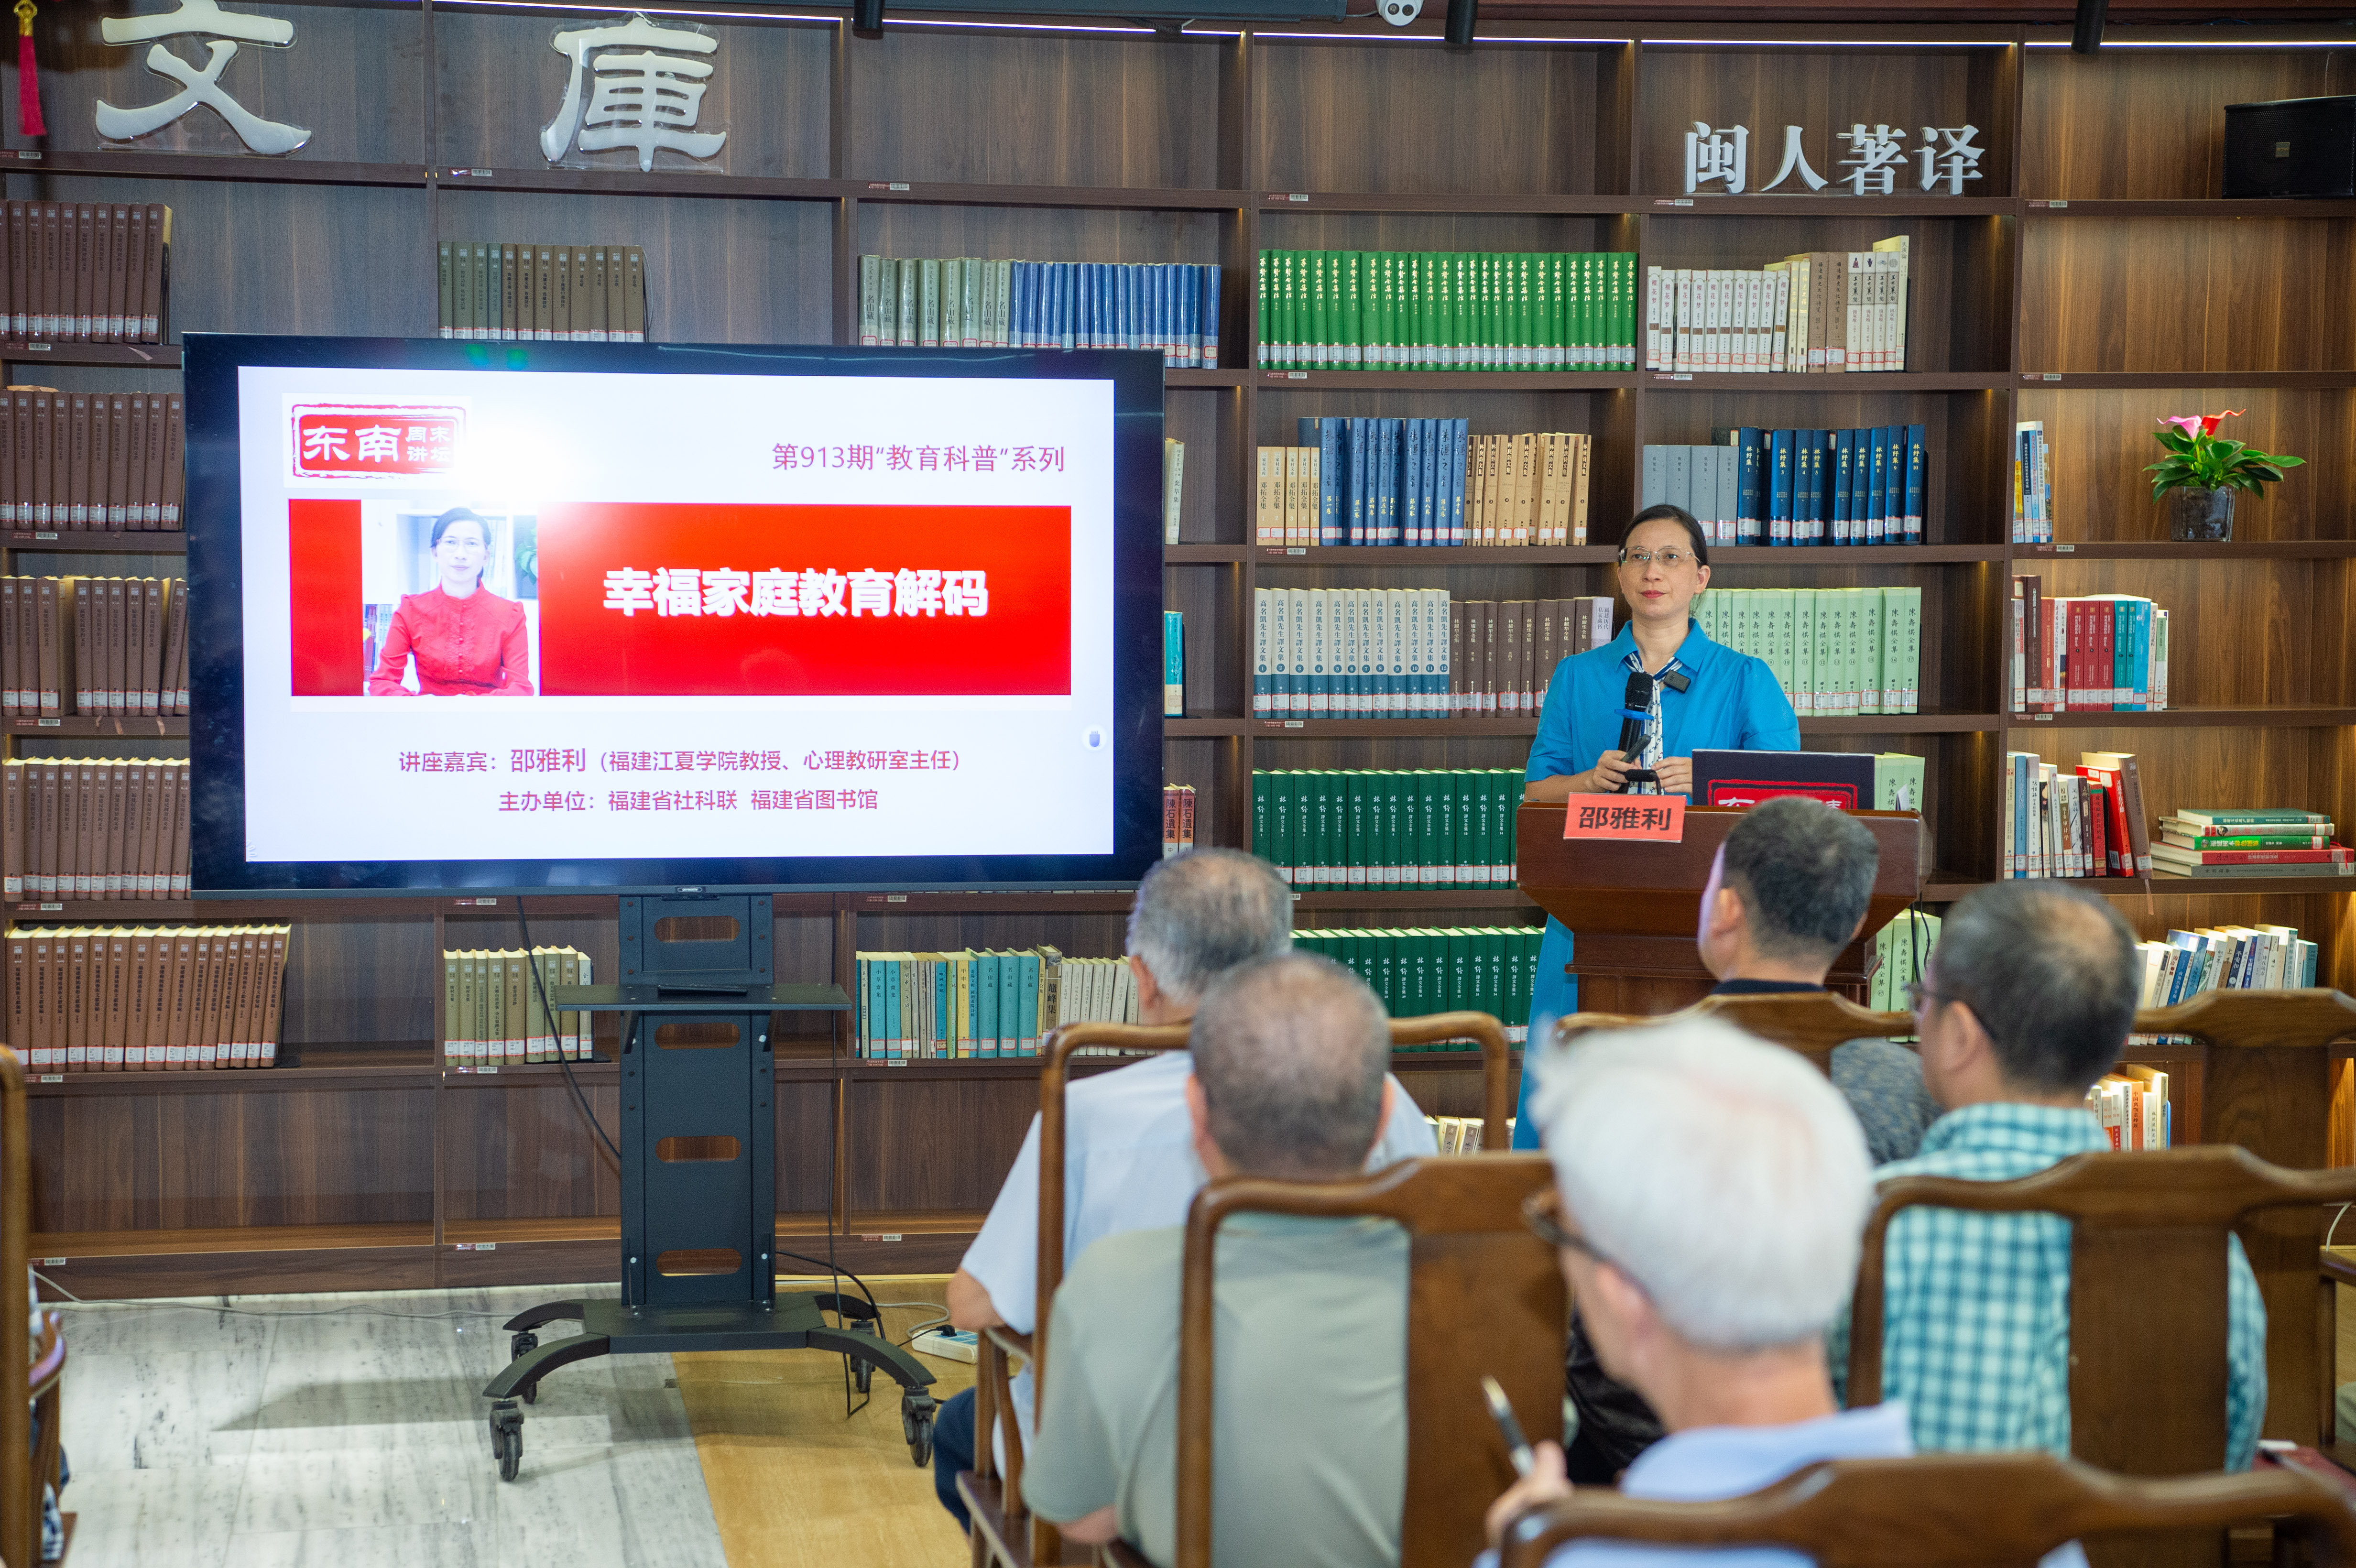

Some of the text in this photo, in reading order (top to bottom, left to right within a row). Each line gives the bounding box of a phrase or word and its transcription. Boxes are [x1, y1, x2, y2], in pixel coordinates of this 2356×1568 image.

[1684, 121, 1985, 195] 闽人著译
[302, 425, 402, 463] 东南
[406, 425, 450, 442] 周末
[603, 567, 989, 617] 幸福家庭教育解码
[751, 788, 879, 812] 福建省图书馆
[1166, 799, 1176, 838] 陳石遺集
[1182, 799, 1192, 838] 陳石遺集
[1579, 806, 1672, 831] 邵雅利
